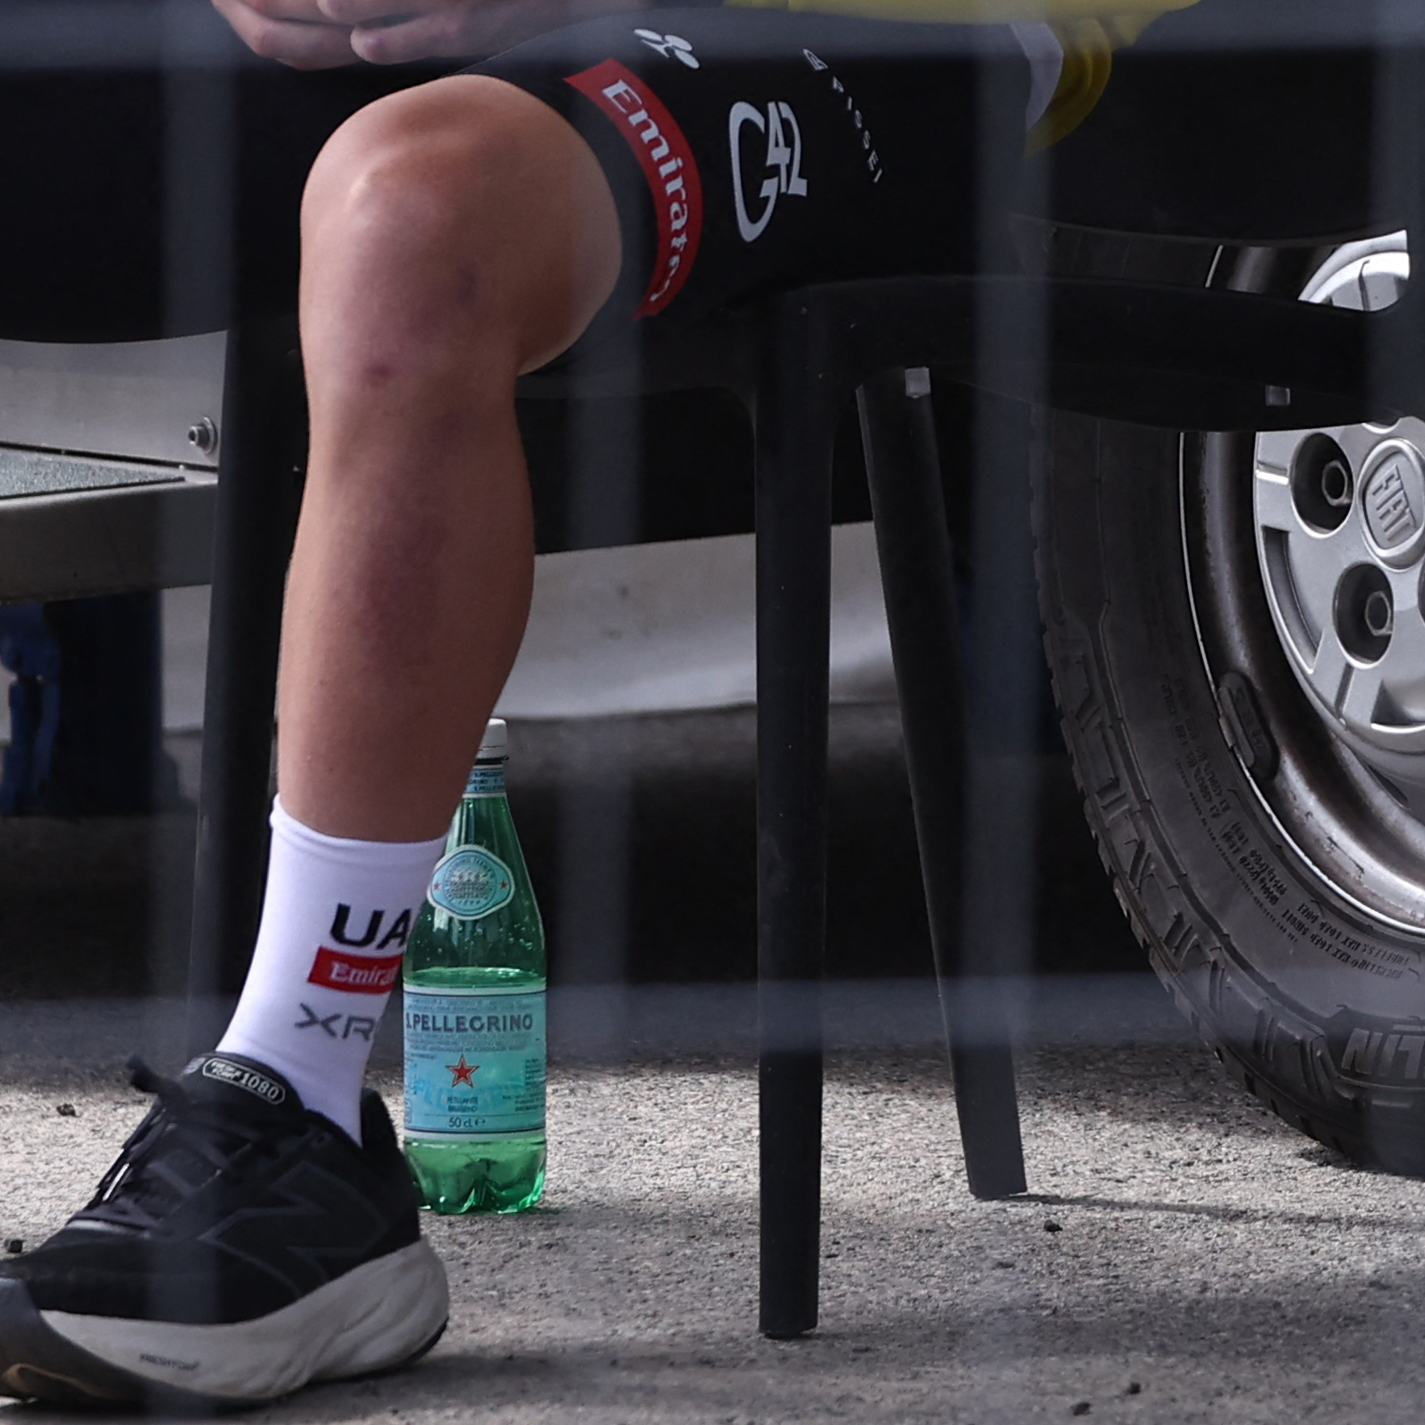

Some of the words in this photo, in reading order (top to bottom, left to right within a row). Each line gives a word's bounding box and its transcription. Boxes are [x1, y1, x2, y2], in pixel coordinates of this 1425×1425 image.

[728, 100, 808, 243] G42
[1371, 464, 1418, 542] FIAT
[330, 902, 412, 951] UA
[329, 960, 399, 986] Emira
[294, 1002, 376, 1042] XR
[240, 1072, 280, 1100] 1080
[449, 1117, 462, 1128] 50
